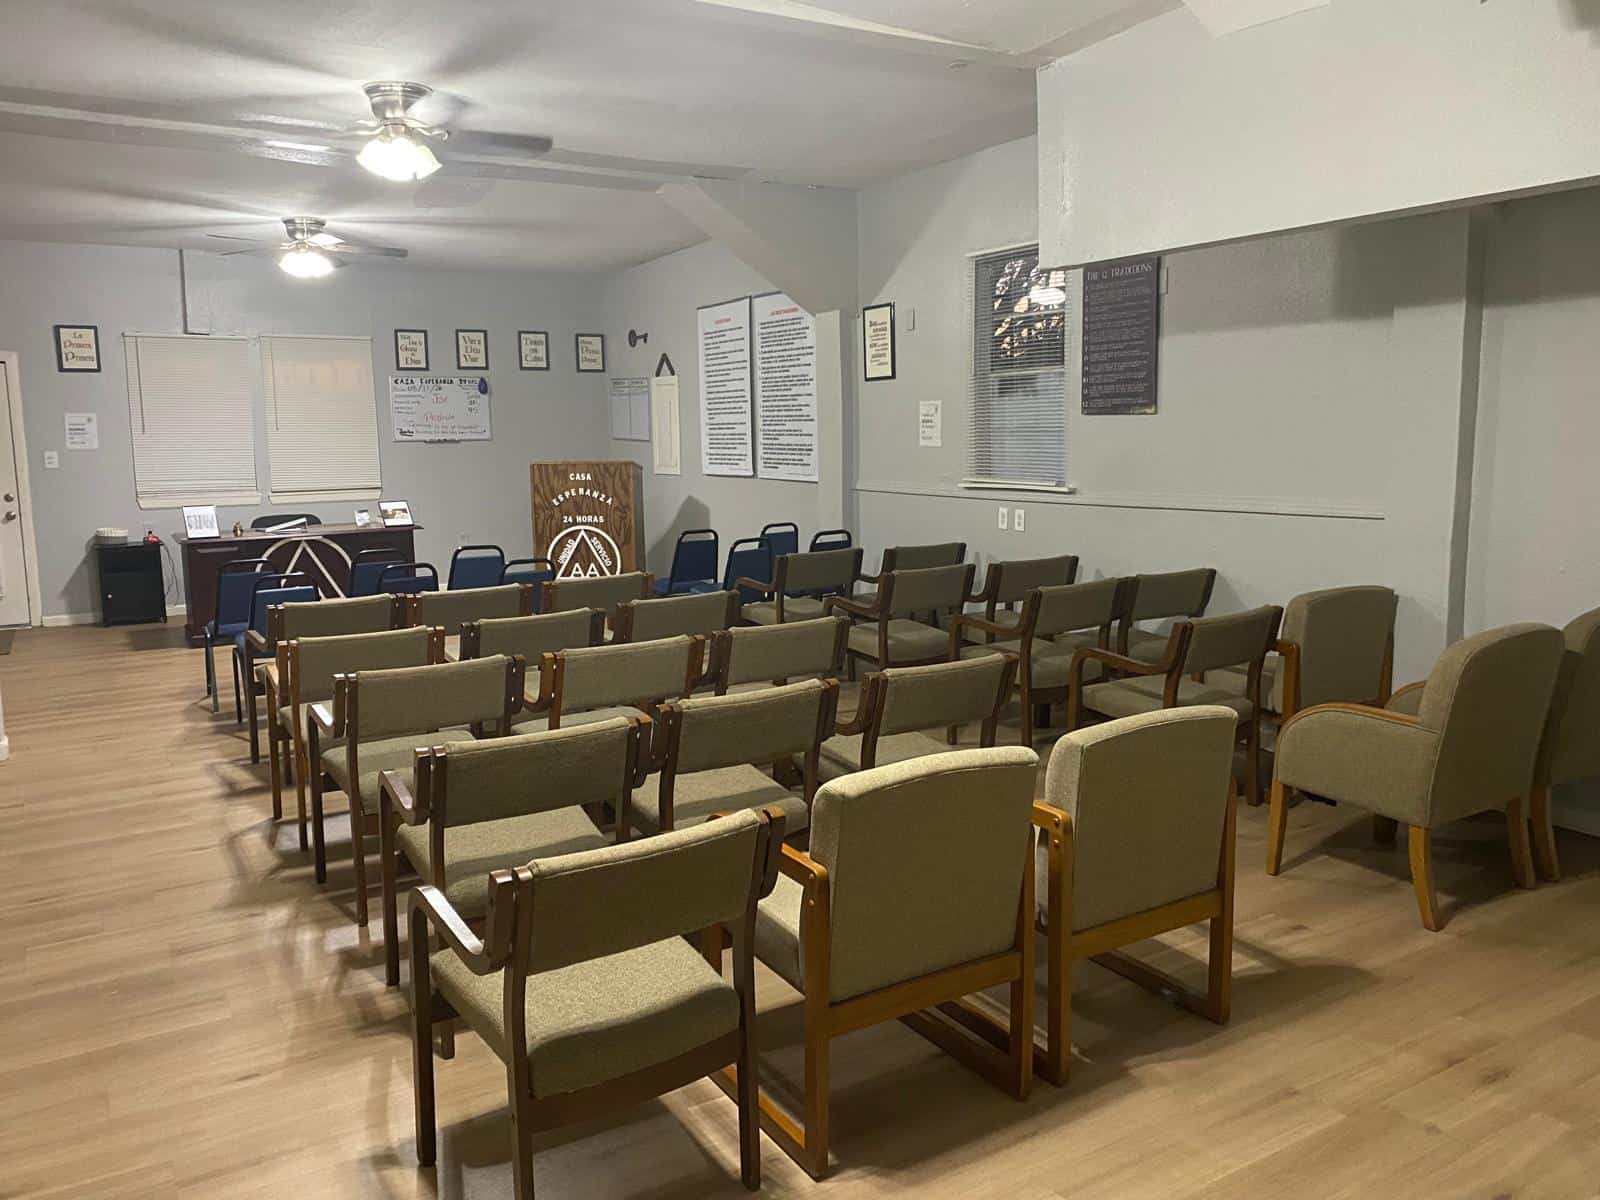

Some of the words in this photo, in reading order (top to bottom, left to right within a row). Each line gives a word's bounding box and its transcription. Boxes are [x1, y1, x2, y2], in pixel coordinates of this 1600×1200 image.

[1111, 263, 1153, 278] TRADITIONS
[569, 472, 592, 481] CASA
[552, 487, 613, 507] ESPERANZA
[563, 515, 573, 523] 24
[576, 515, 605, 523] HORAS
[590, 536, 613, 568] SERVICIO
